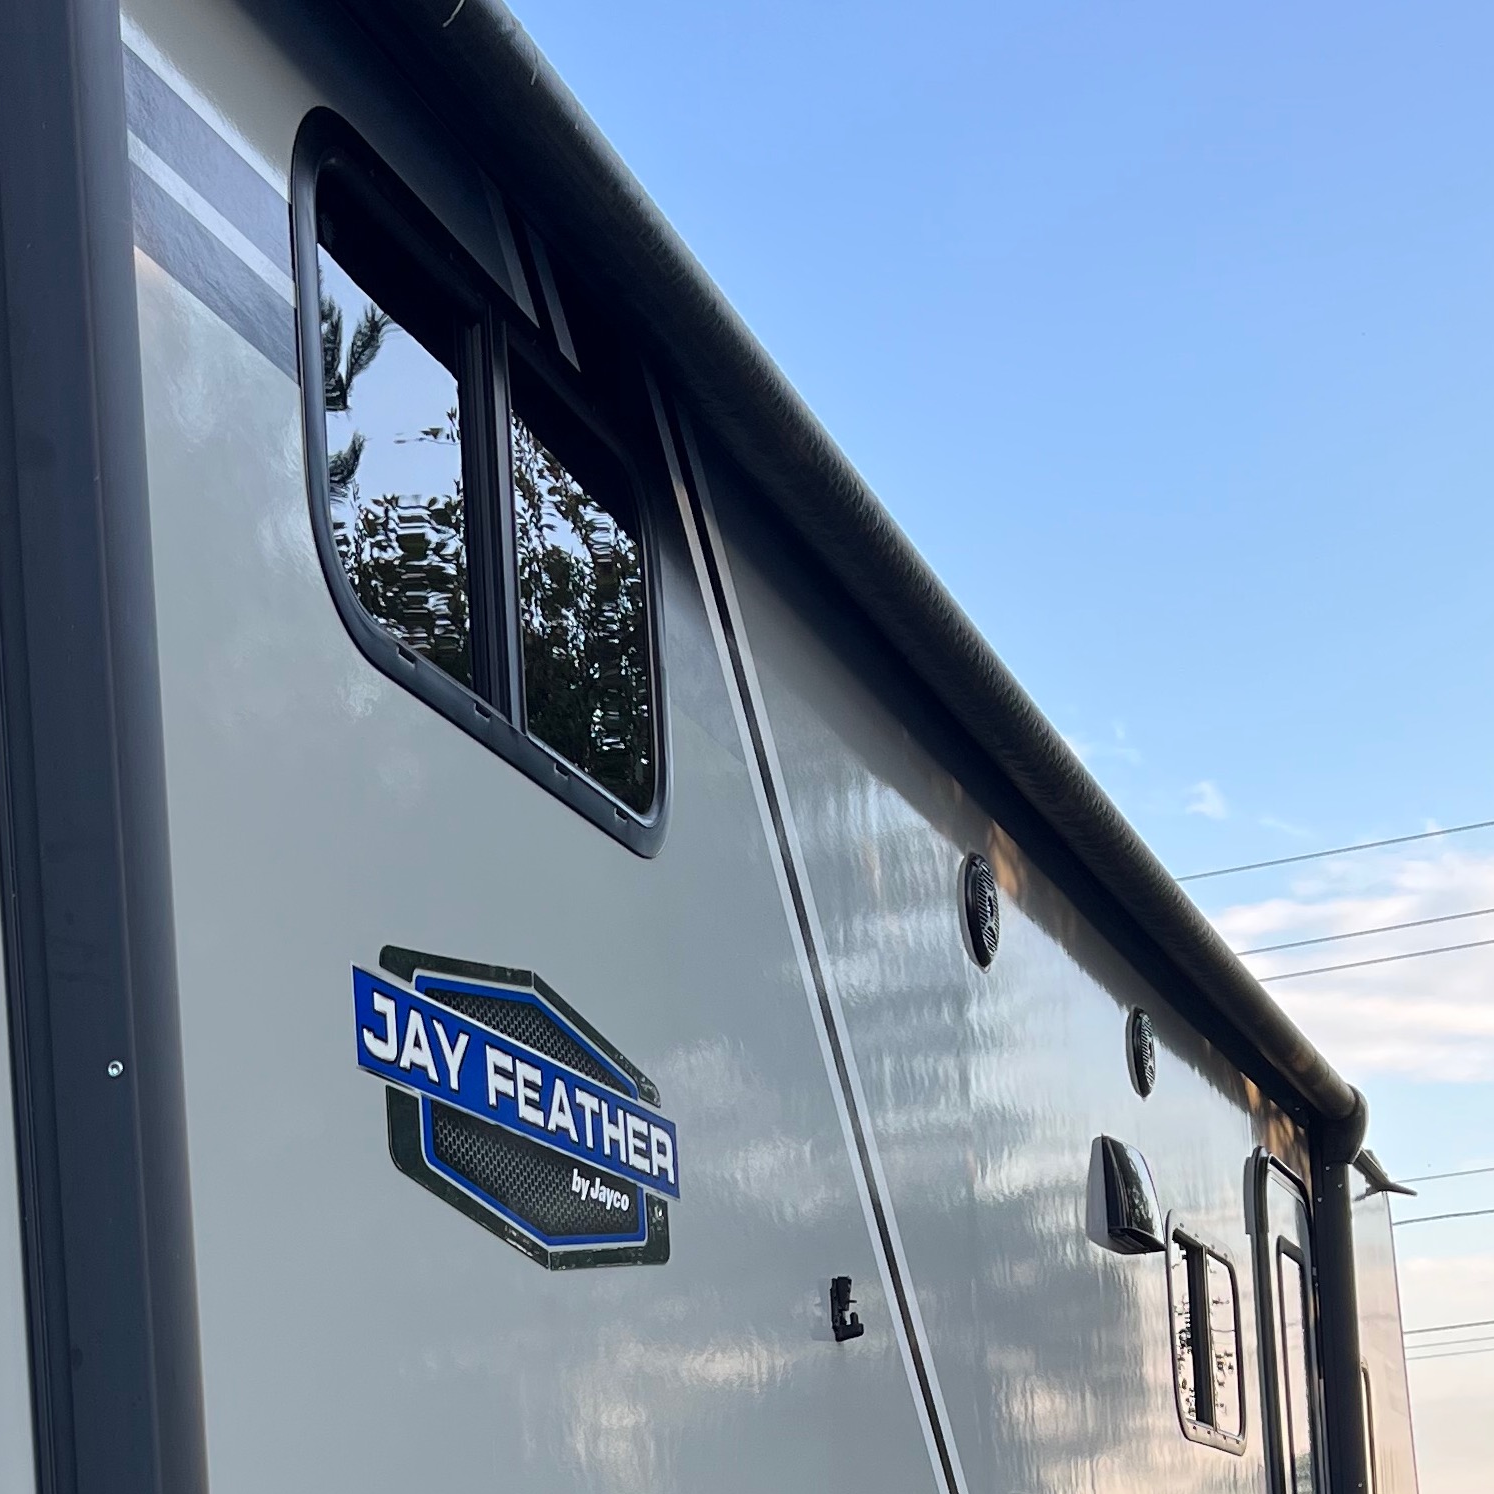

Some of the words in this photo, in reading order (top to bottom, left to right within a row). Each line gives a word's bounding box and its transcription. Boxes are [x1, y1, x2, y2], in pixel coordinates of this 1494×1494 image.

[363, 991, 469, 1091] JAY
[486, 1043, 676, 1185] FEATHER
[571, 1168, 590, 1201] by
[590, 1177, 630, 1211] Jayco
